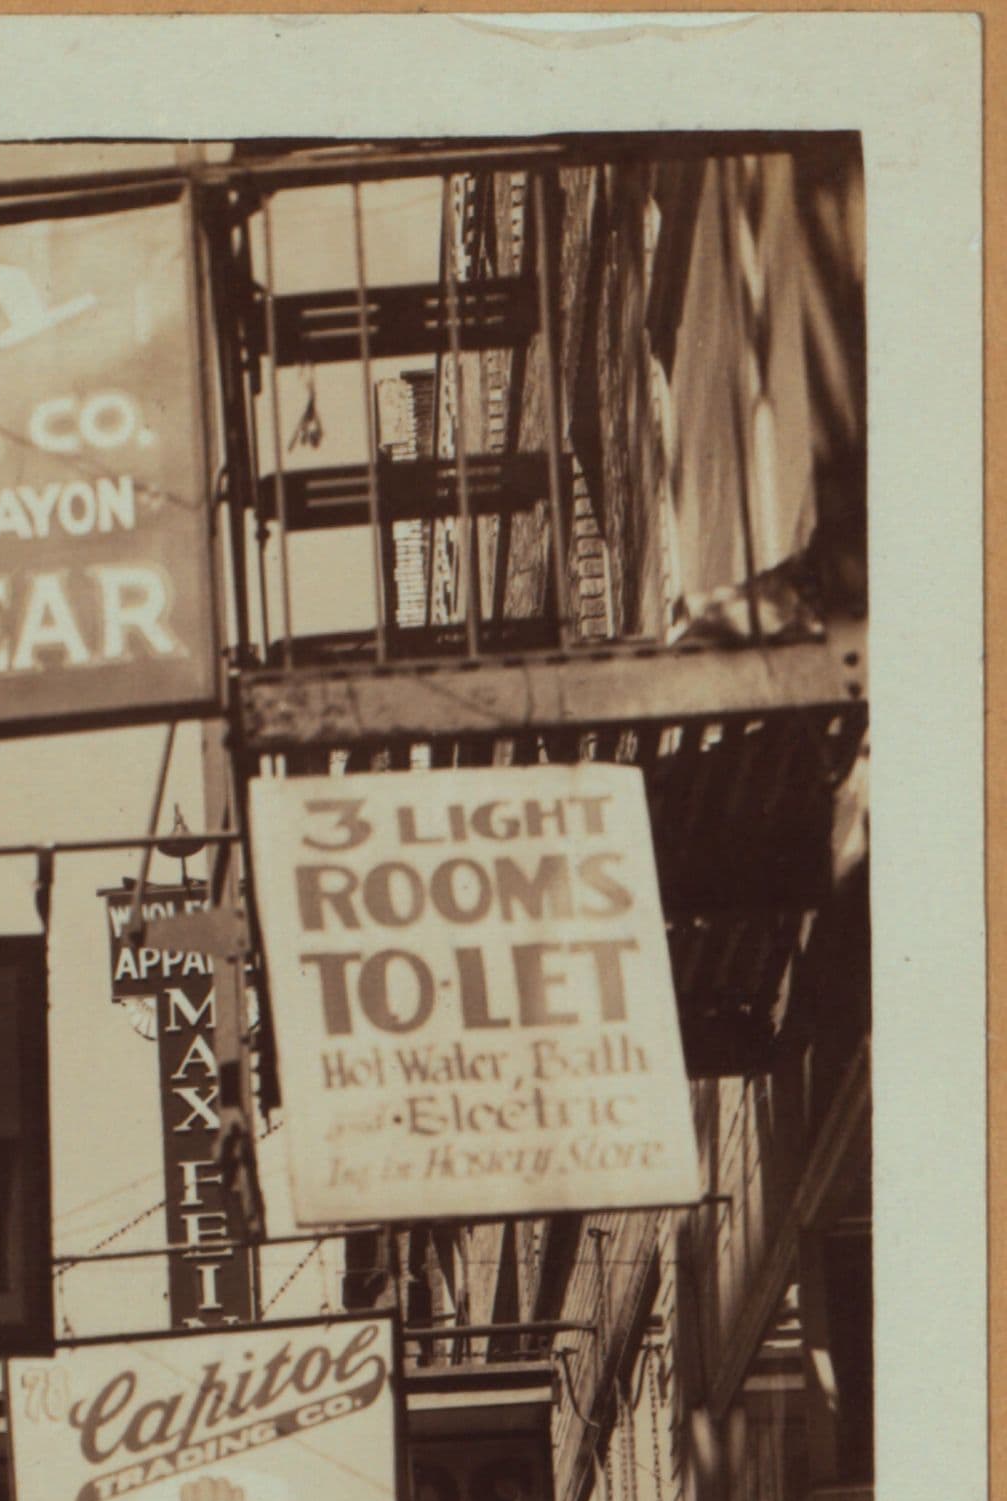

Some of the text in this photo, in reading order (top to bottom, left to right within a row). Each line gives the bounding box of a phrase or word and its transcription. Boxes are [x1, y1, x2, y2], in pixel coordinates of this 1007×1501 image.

[29, 392, 158, 453] CO.
[303, 794, 615, 852] 3 LIGHT
[296, 852, 636, 931] ROOMS
[320, 1035, 649, 1091] Hot Water, Bath
[164, 988, 239, 1327] MAX FEI
[69, 1324, 387, 1464] Capitol
[95, 1396, 364, 1499] TRADING CO.
